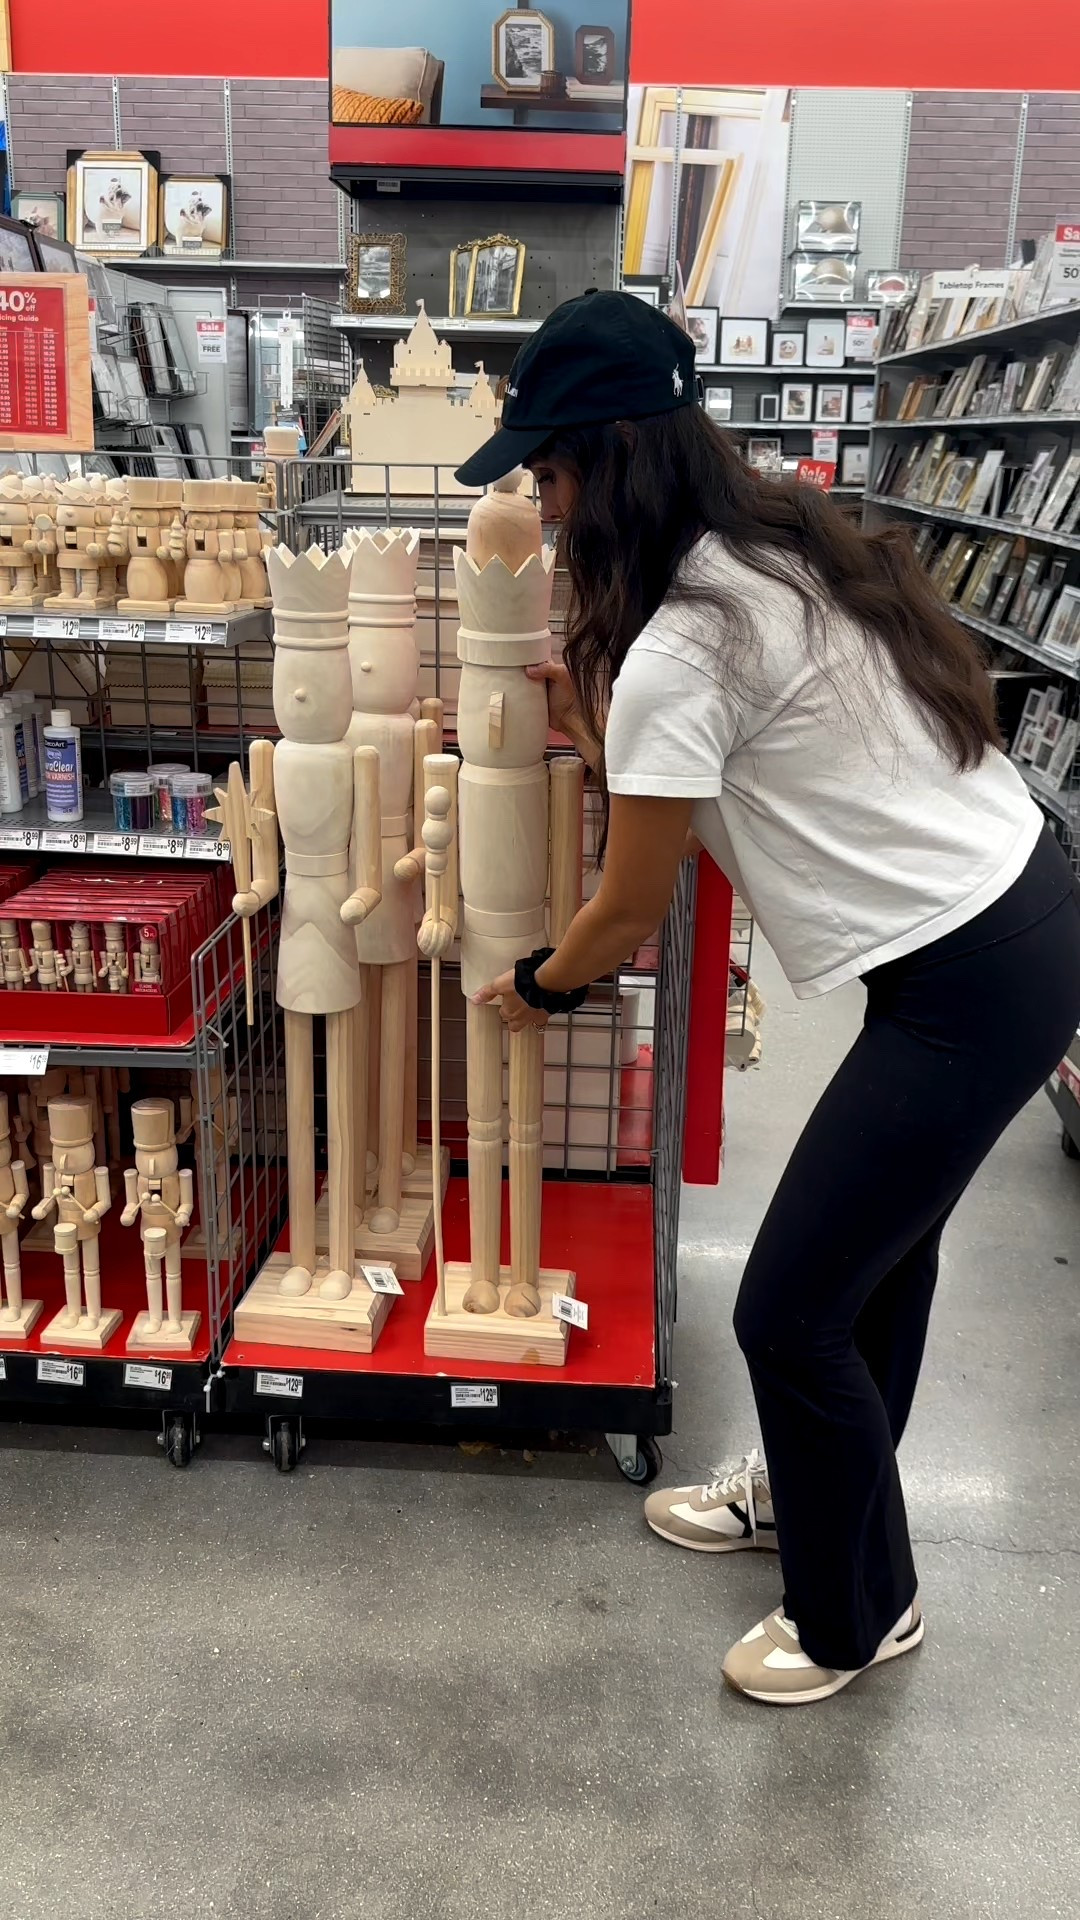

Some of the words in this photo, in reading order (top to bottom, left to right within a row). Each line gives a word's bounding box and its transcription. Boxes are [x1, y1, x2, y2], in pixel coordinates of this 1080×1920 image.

[939, 281, 974, 290] Tabletop
[975, 281, 1004, 289] Frames
[25, 304, 36, 312] off
[17, 314, 39, 322] Guide
[201, 322, 220, 330] Sale
[202, 345, 221, 353] FREE
[798, 464, 827, 486] Sale
[143, 928, 150, 938] 5
